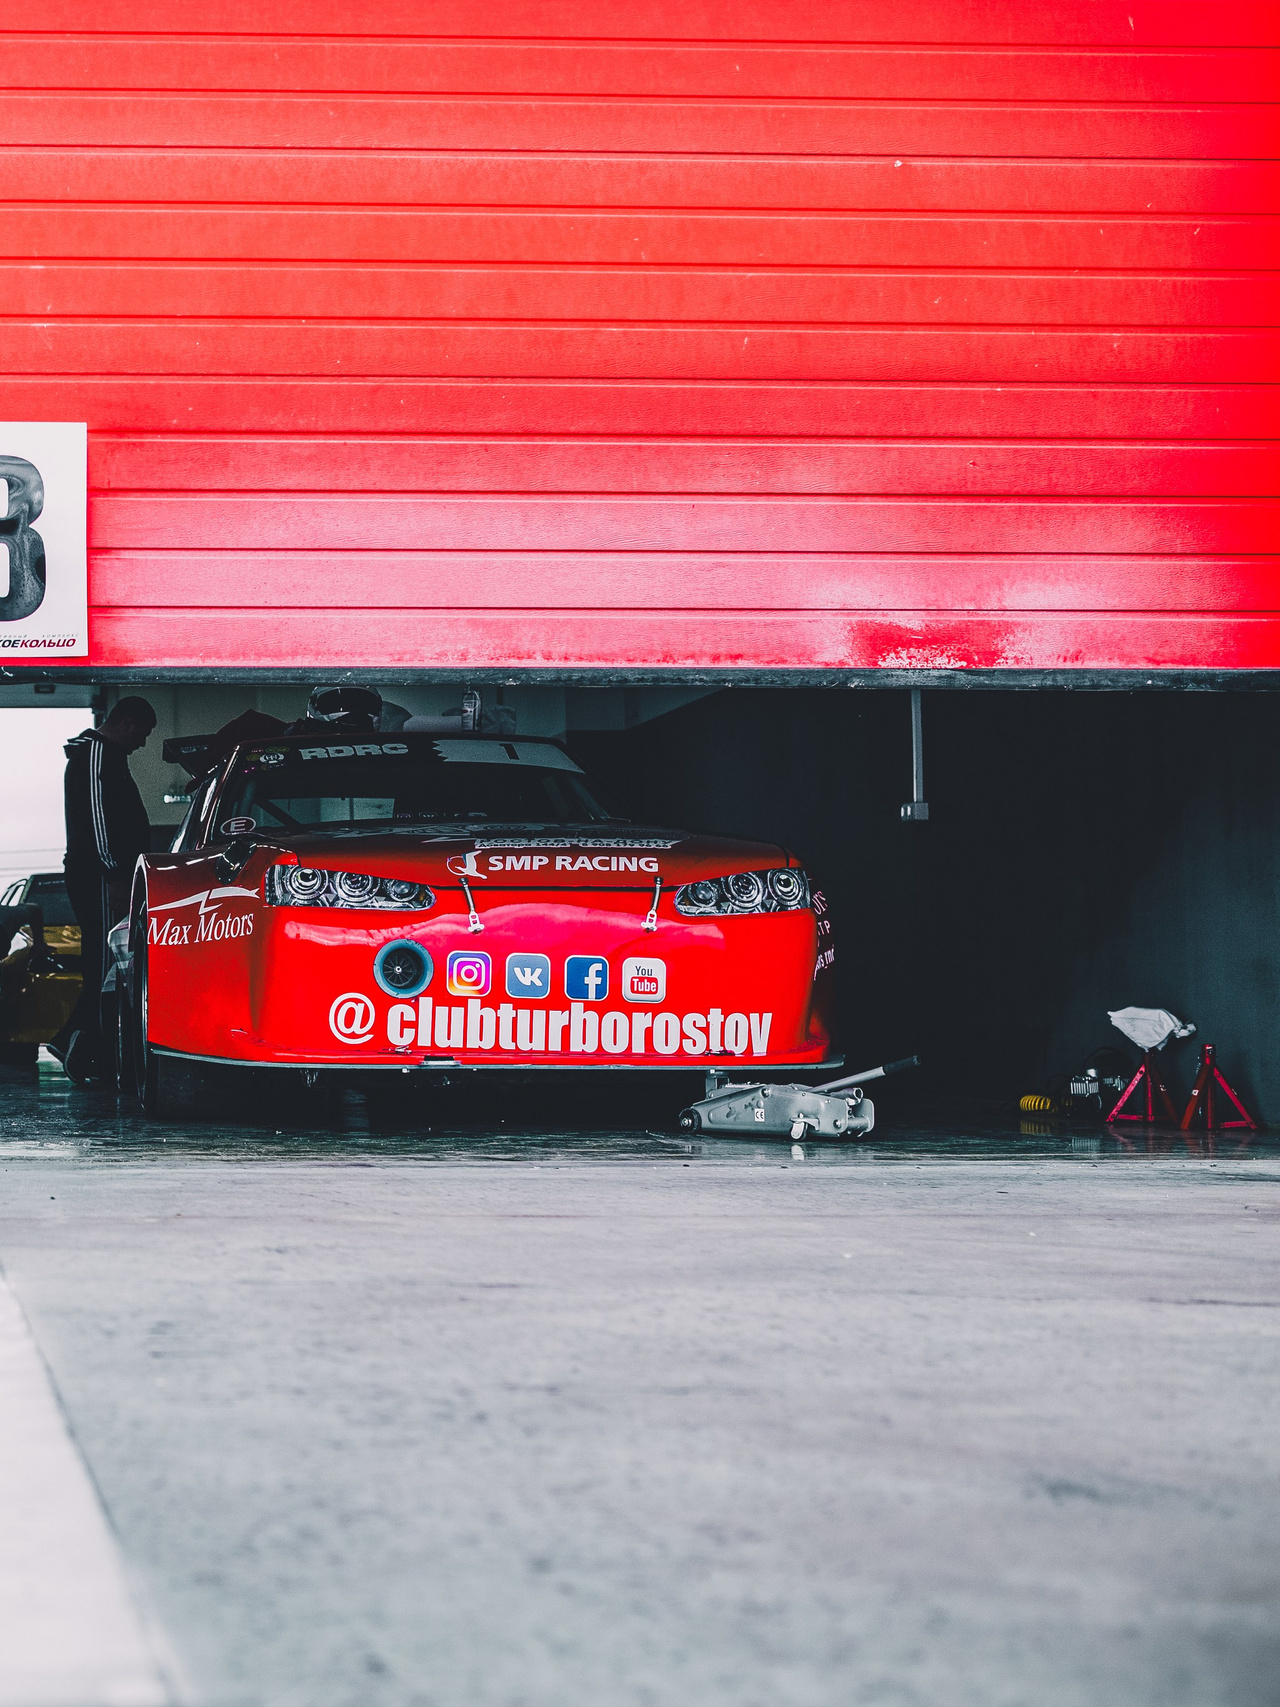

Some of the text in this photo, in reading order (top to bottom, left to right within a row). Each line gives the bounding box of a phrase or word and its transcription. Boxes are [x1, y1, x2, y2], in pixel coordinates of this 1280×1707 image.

[298, 743, 409, 760] RDRC
[498, 743, 521, 761] 1
[488, 855, 659, 872] SMP RACING
[147, 912, 254, 946] Max Motors
[634, 965, 654, 977] You
[632, 978, 657, 993] Tube
[387, 996, 773, 1057] clubturborostov
